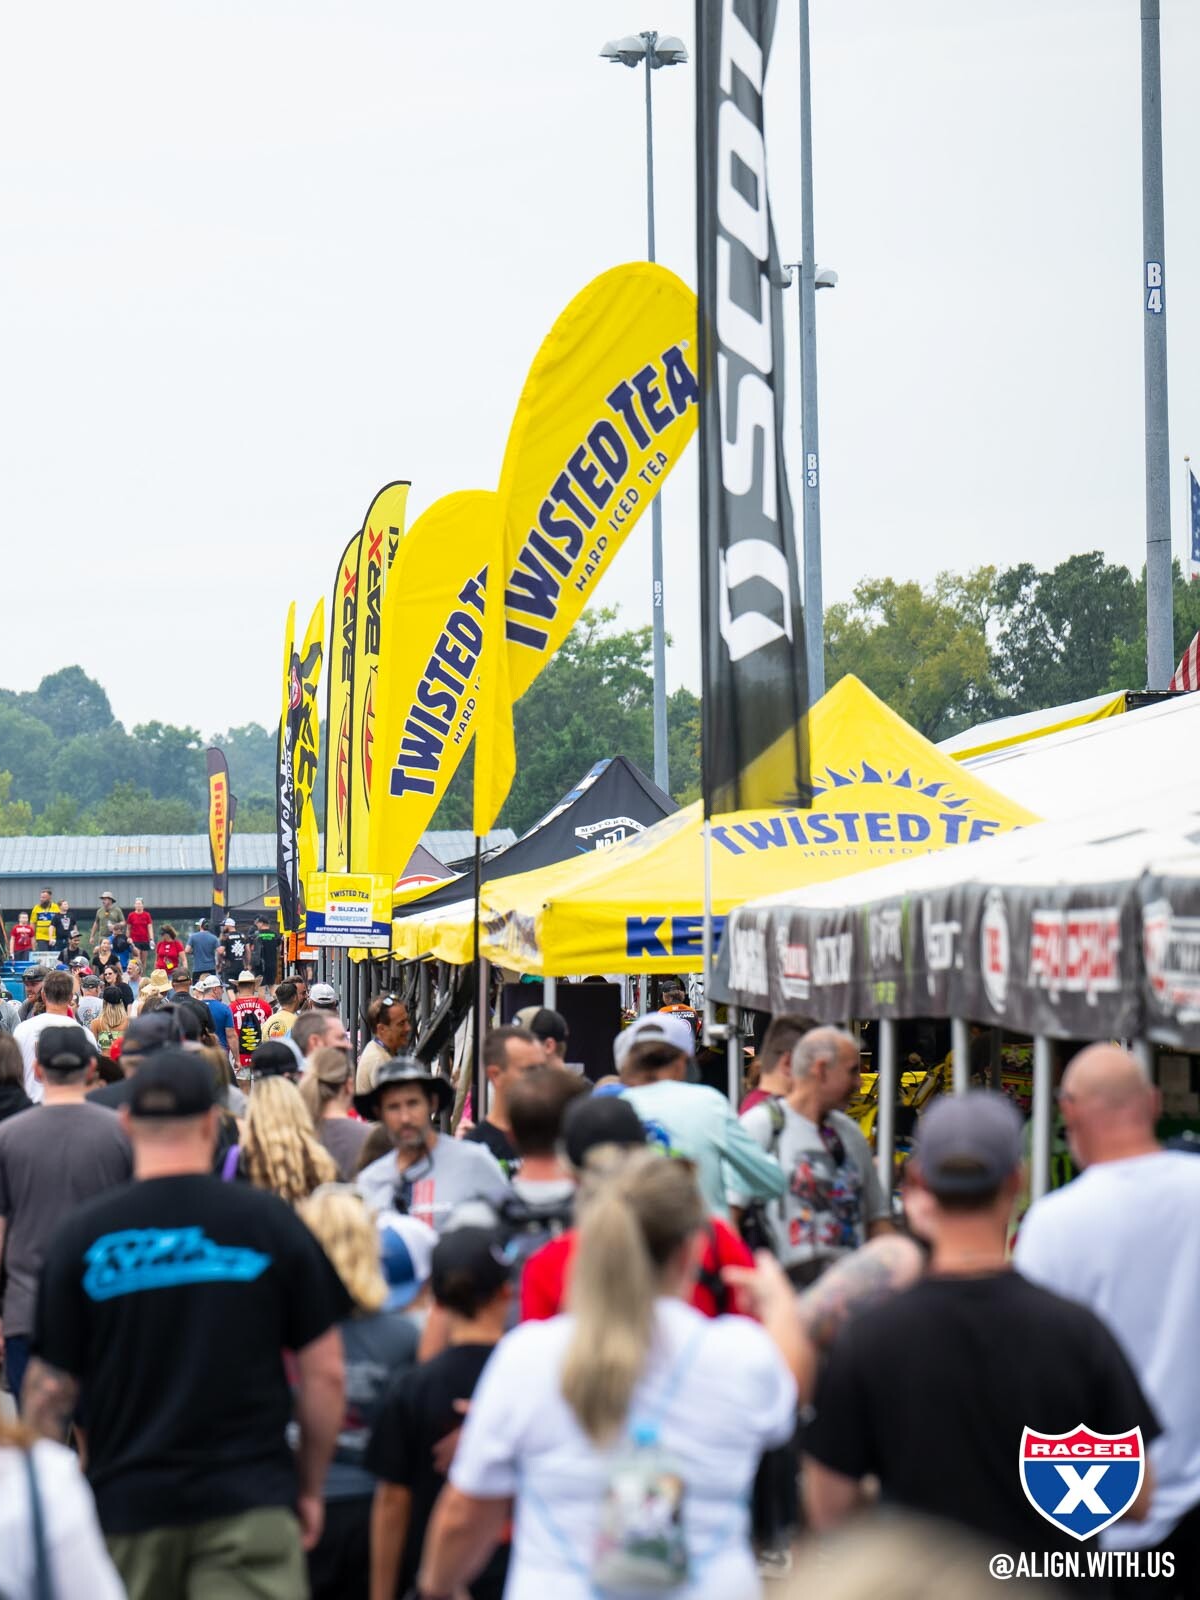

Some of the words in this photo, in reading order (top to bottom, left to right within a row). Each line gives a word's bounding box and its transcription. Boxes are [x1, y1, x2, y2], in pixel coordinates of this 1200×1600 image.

[605, 344, 699, 452] TEA
[574, 535, 609, 592] HARD
[608, 487, 641, 533] ICED
[638, 451, 669, 485] TEA
[365, 525, 385, 656] BARX
[389, 610, 484, 798] TWISTED
[453, 698, 476, 745] HARD
[701, 811, 931, 856] TWISTED
[938, 812, 1025, 844] TE
[803, 848, 858, 858] HARD
[868, 847, 914, 856] ICED
[330, 889, 357, 899] TWISTED
[358, 891, 369, 900] TEA
[626, 915, 728, 957] KE
